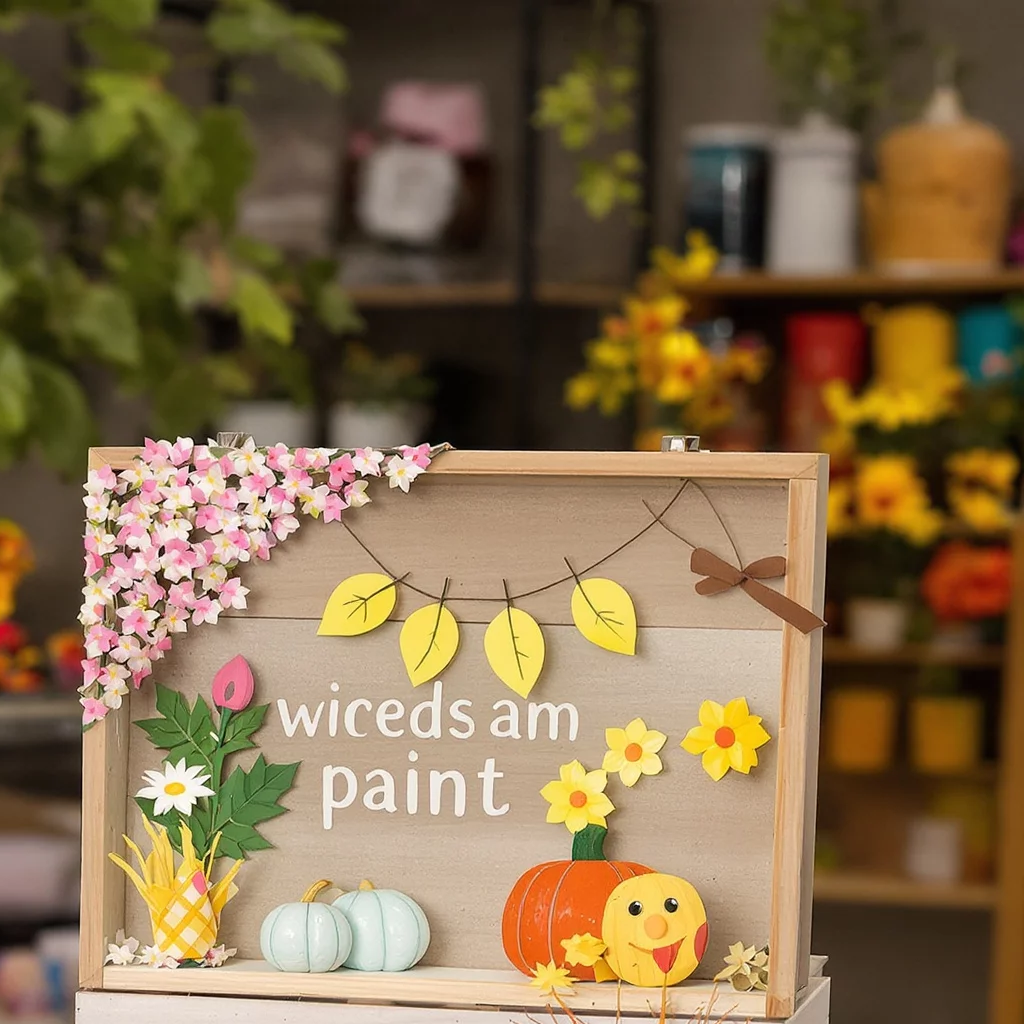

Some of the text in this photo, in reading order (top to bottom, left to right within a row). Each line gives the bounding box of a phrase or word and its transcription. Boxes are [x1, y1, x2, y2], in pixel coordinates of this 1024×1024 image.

[277, 680, 579, 741] wiceds am
[322, 750, 510, 830] paint
